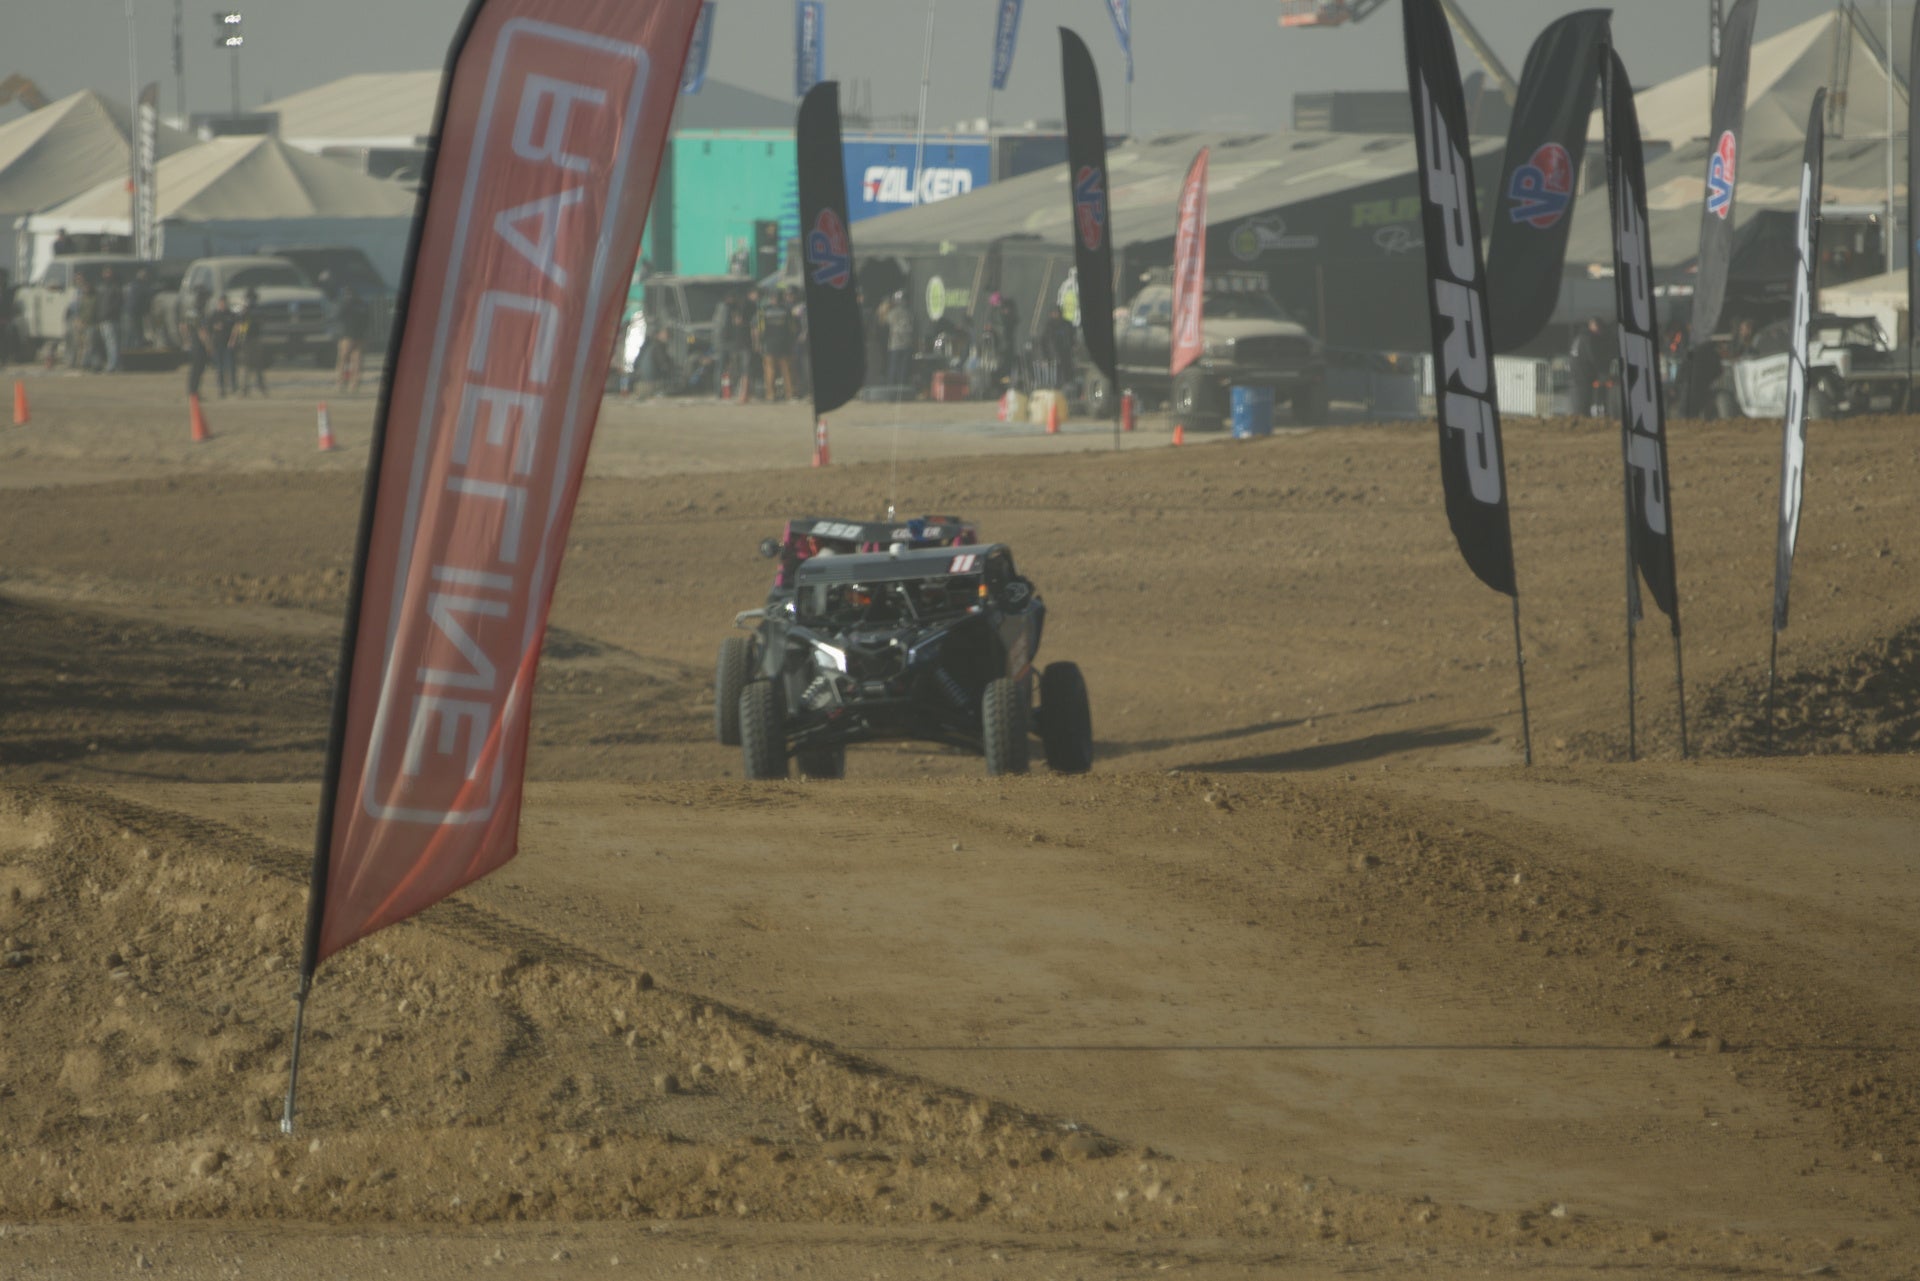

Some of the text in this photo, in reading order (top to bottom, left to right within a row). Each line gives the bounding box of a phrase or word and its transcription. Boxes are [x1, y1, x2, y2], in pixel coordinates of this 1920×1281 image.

[863, 166, 973, 204] FALKEN
[1509, 164, 1570, 223] VP
[1707, 152, 1734, 223] VP
[807, 230, 850, 285] VP
[950, 554, 976, 573] 11
